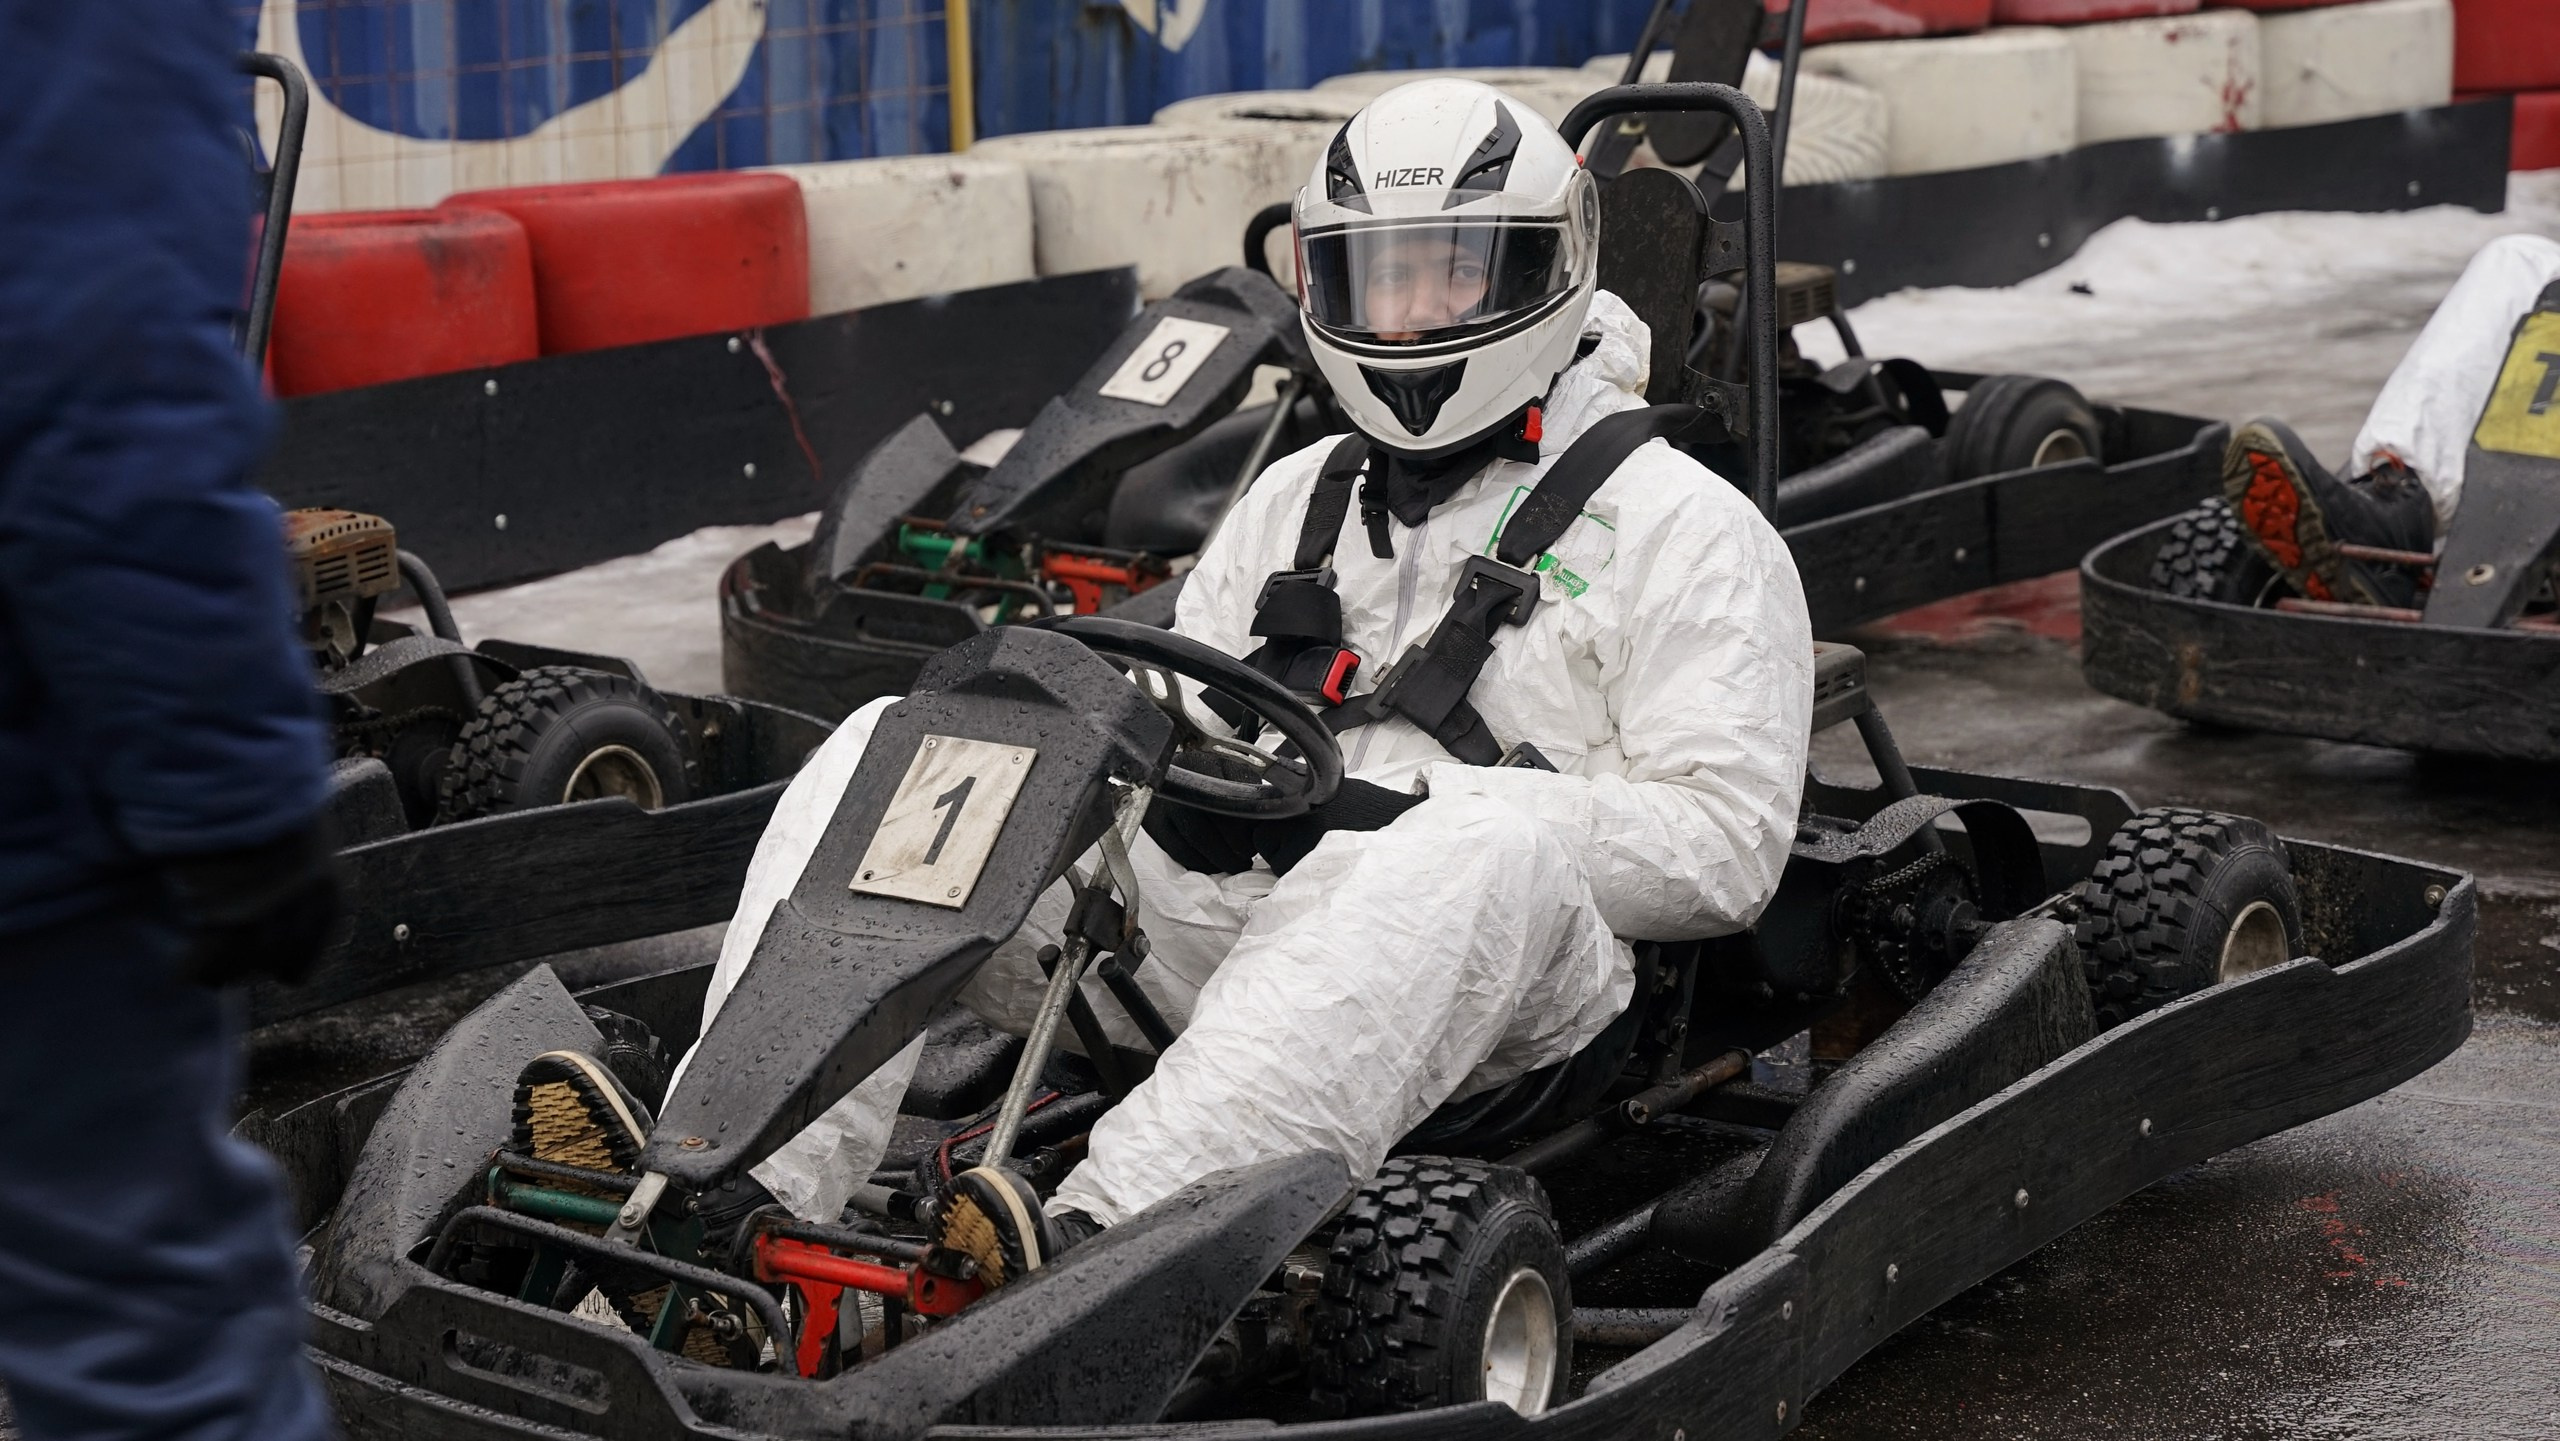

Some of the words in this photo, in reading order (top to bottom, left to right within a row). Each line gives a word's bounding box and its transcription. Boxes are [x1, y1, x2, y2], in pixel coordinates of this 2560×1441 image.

[1374, 167, 1444, 190] HIZER
[1141, 340, 1187, 382] 8
[922, 775, 977, 866] 1
